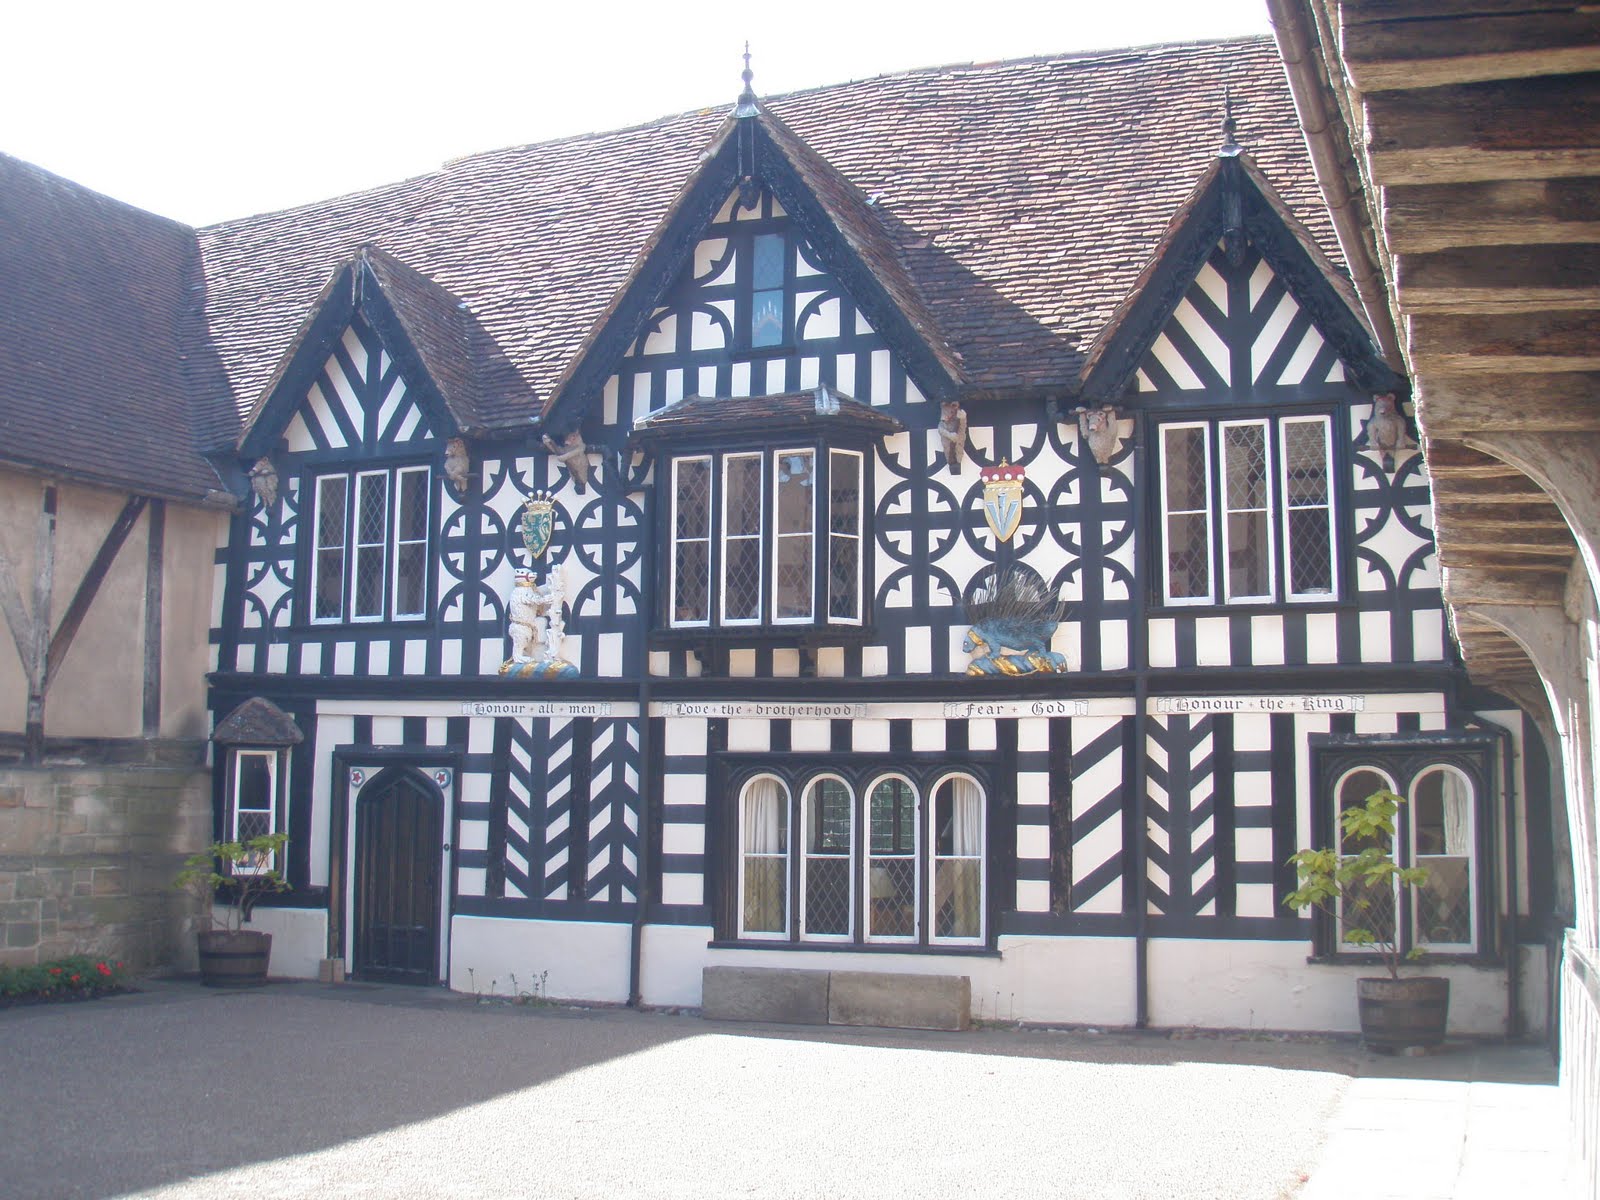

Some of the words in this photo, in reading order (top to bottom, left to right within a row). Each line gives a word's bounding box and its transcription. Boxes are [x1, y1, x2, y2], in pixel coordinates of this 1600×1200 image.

[474, 703, 527, 715] Honour
[538, 703, 555, 714] all
[568, 704, 597, 715] men
[676, 703, 710, 716] Love
[721, 704, 742, 716] the
[756, 704, 851, 717] brotherhood
[961, 703, 1004, 717] Fear
[1031, 701, 1066, 716] God
[1176, 698, 1244, 712] Honour
[1260, 698, 1285, 711] the
[1302, 696, 1345, 711] King
